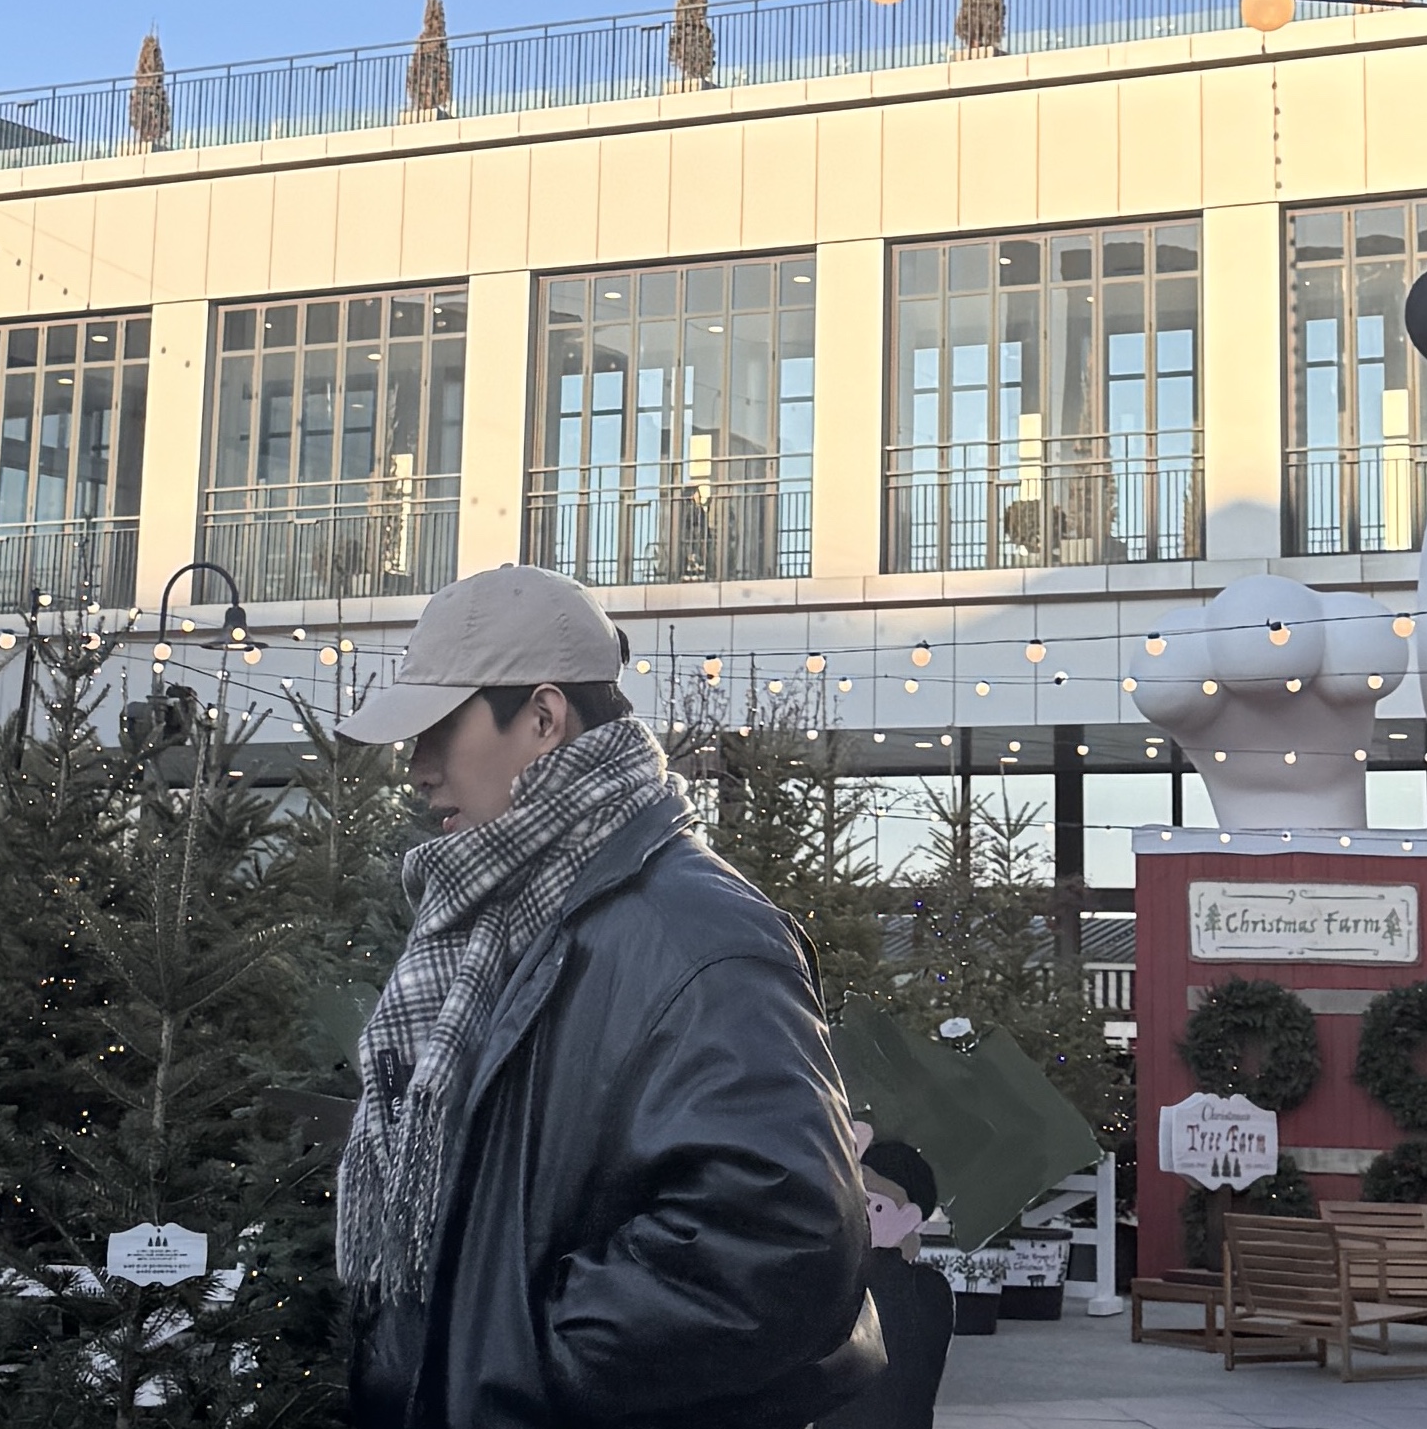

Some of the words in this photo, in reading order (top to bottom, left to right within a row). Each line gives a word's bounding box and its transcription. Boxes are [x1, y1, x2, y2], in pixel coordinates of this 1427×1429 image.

[1225, 909, 1317, 934] Christmas
[1324, 911, 1382, 936] Farm
[1201, 1102, 1251, 1122] Christmas
[1187, 1124, 1222, 1152] Tree
[1226, 1124, 1266, 1154] Farm
